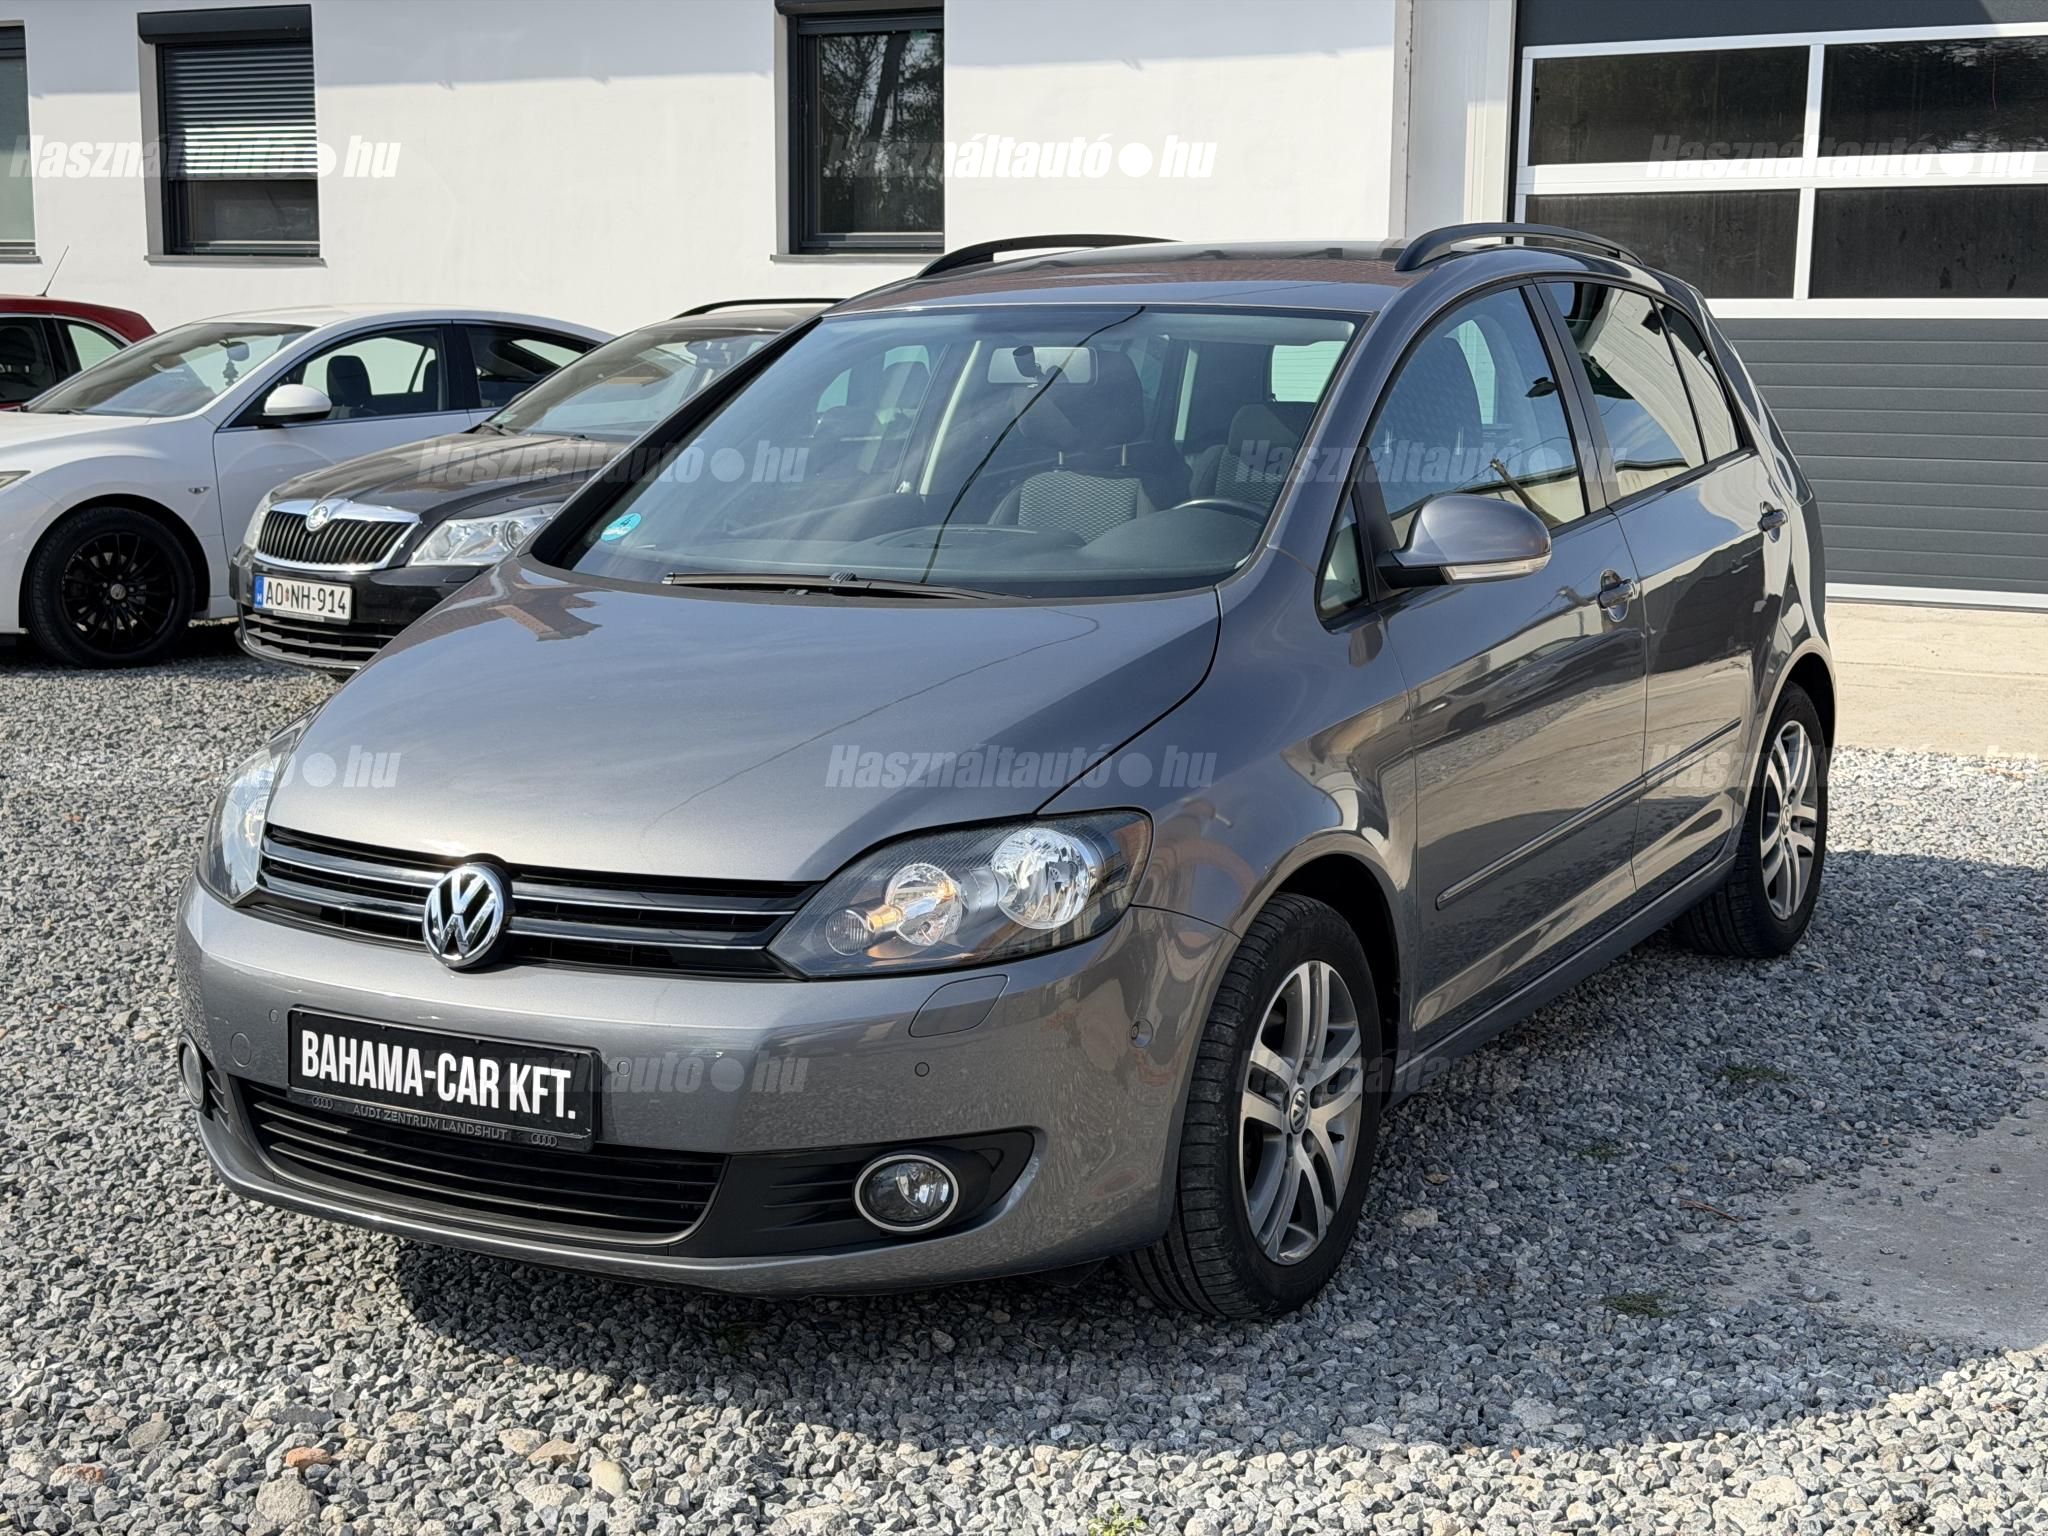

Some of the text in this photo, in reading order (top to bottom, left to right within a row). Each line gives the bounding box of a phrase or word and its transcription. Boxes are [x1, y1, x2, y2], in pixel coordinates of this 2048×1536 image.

[302, 1030, 576, 1119] BAHAMA-CAR KFT.
[352, 1104, 508, 1141] AUDI ZENTRUM LANDSHUT
